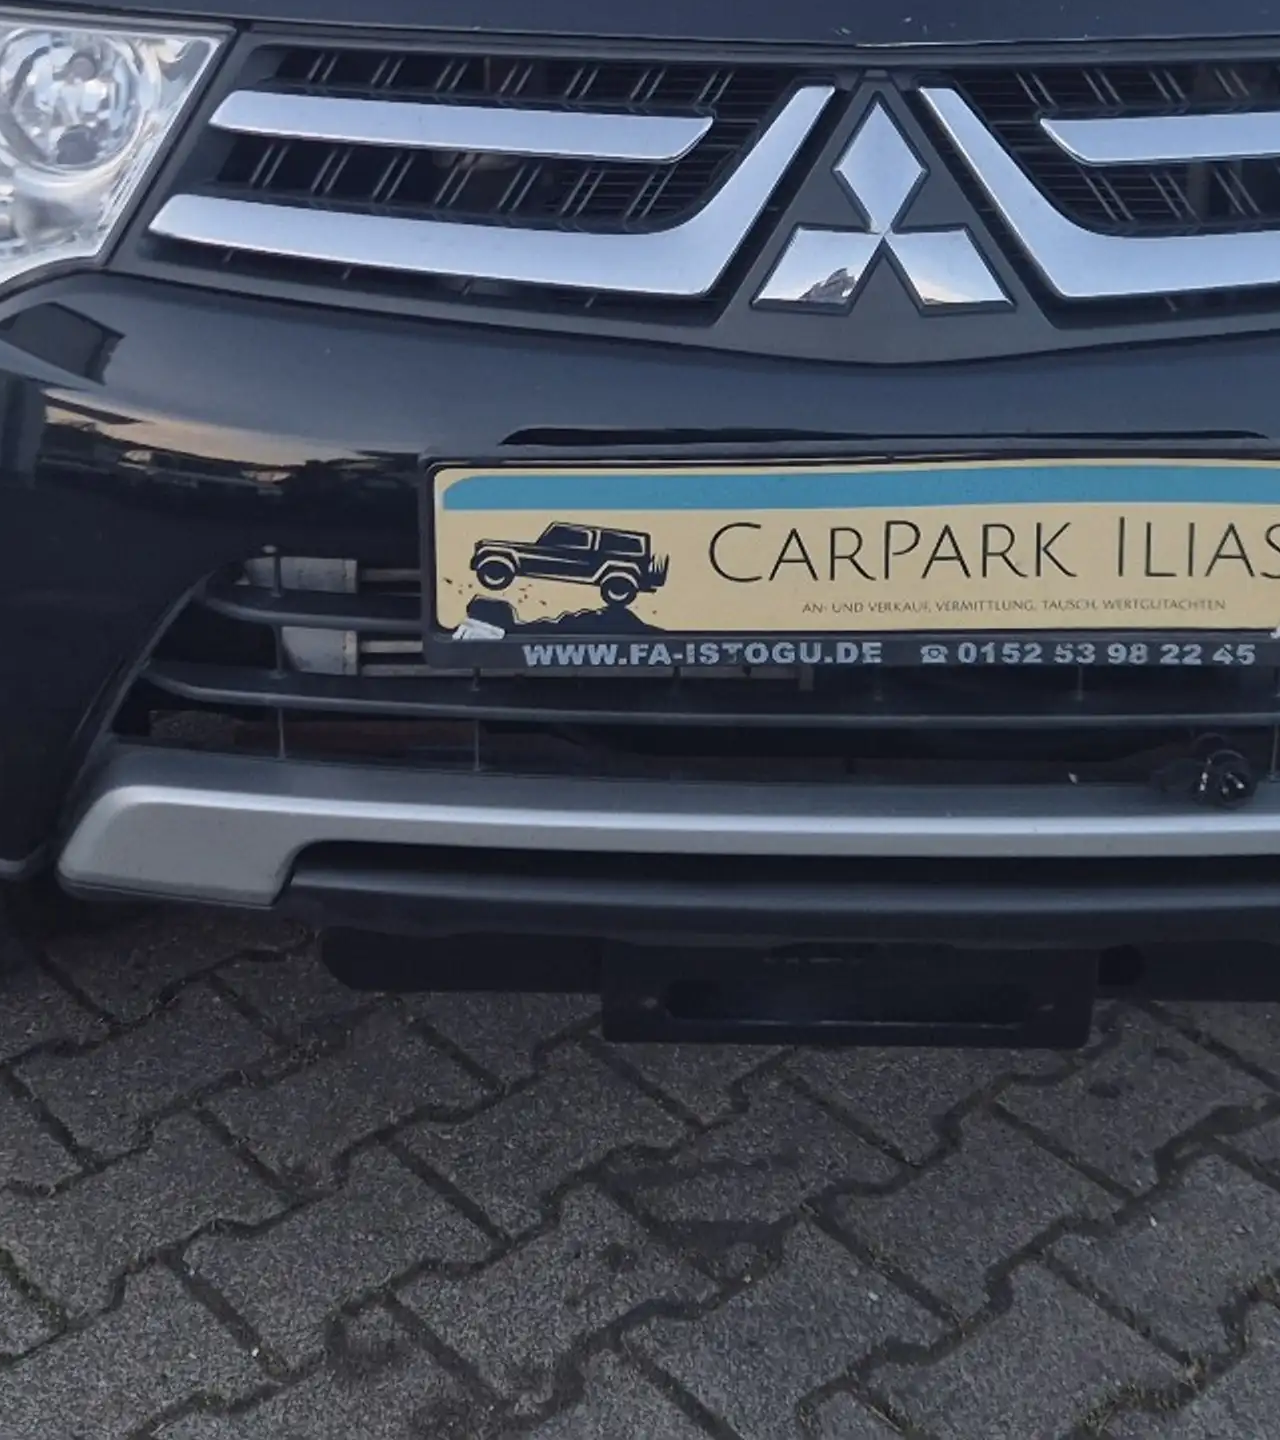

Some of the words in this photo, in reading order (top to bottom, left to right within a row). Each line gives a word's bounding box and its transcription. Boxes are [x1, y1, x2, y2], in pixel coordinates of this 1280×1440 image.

[831, 602, 865, 614] UND
[1102, 597, 1227, 611] WERTGUTACHTEN
[957, 641, 1044, 666] 0152
[1053, 642, 1097, 665] 53
[1106, 641, 1150, 666] 98
[1159, 642, 1203, 666] 22
[1211, 643, 1257, 666] 45
